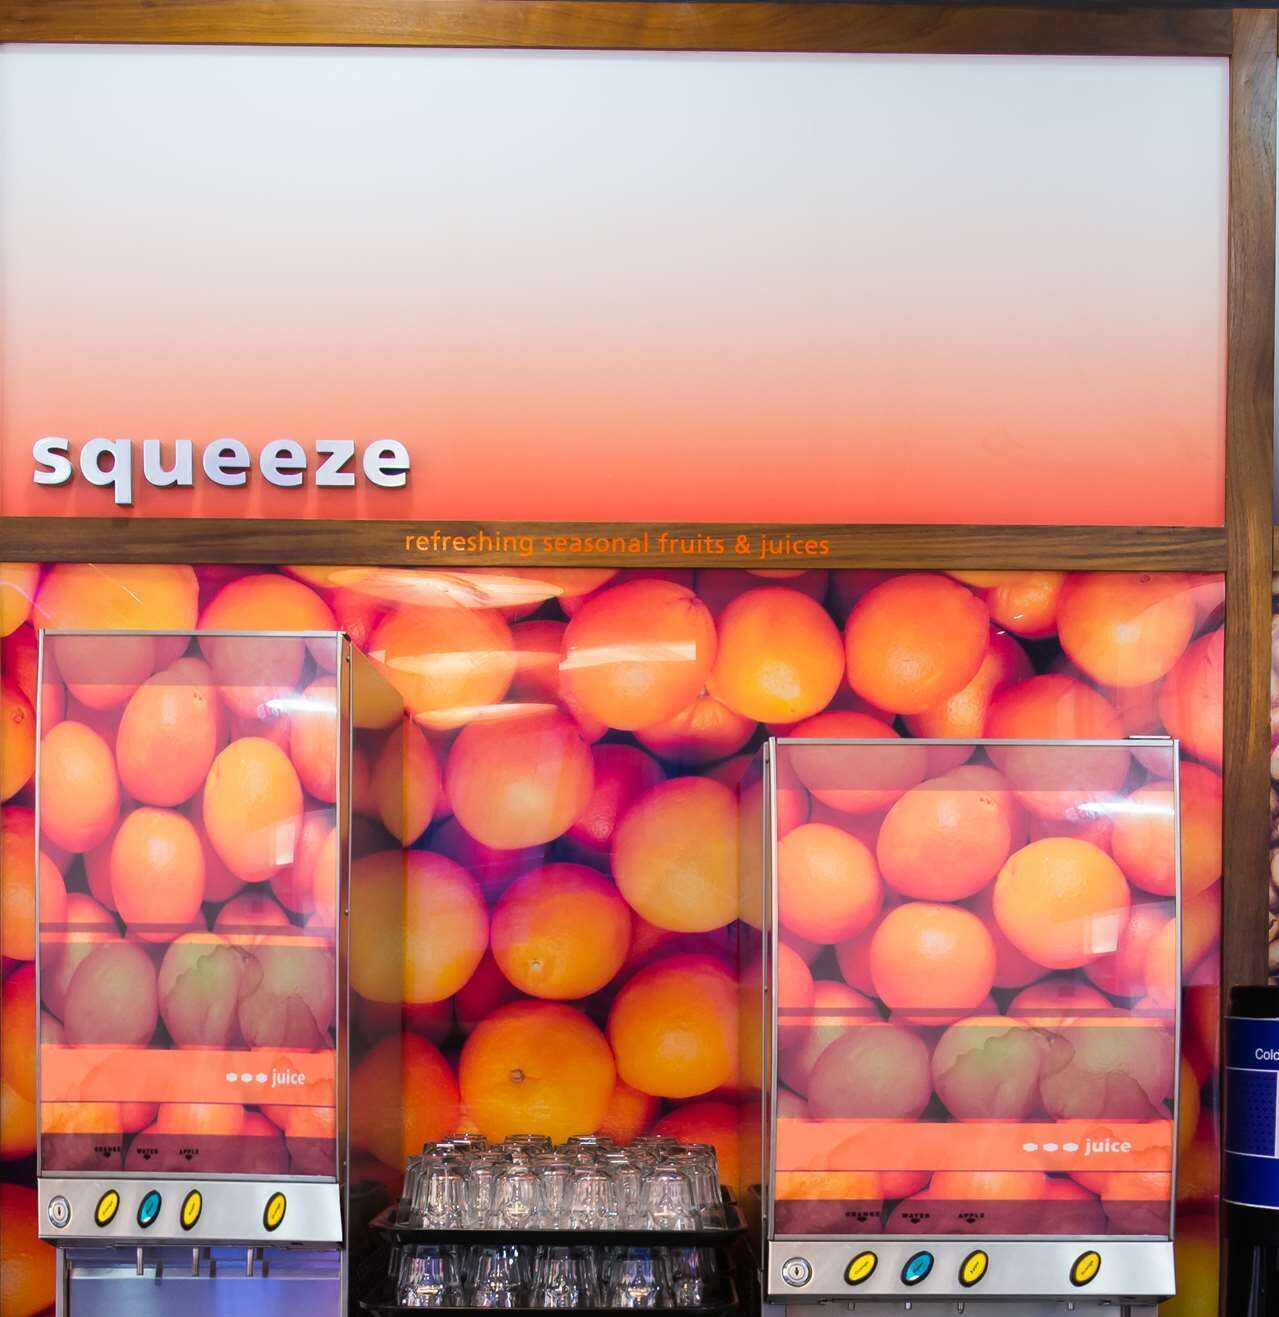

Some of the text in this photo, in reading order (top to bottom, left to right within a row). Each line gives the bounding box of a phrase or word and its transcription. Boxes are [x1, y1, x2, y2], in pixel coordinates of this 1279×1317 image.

[32, 434, 412, 505] squeeze
[404, 529, 831, 560] refreshing seasonal fruits & juices
[271, 1068, 306, 1088] juice
[1084, 1138, 1132, 1155] juice
